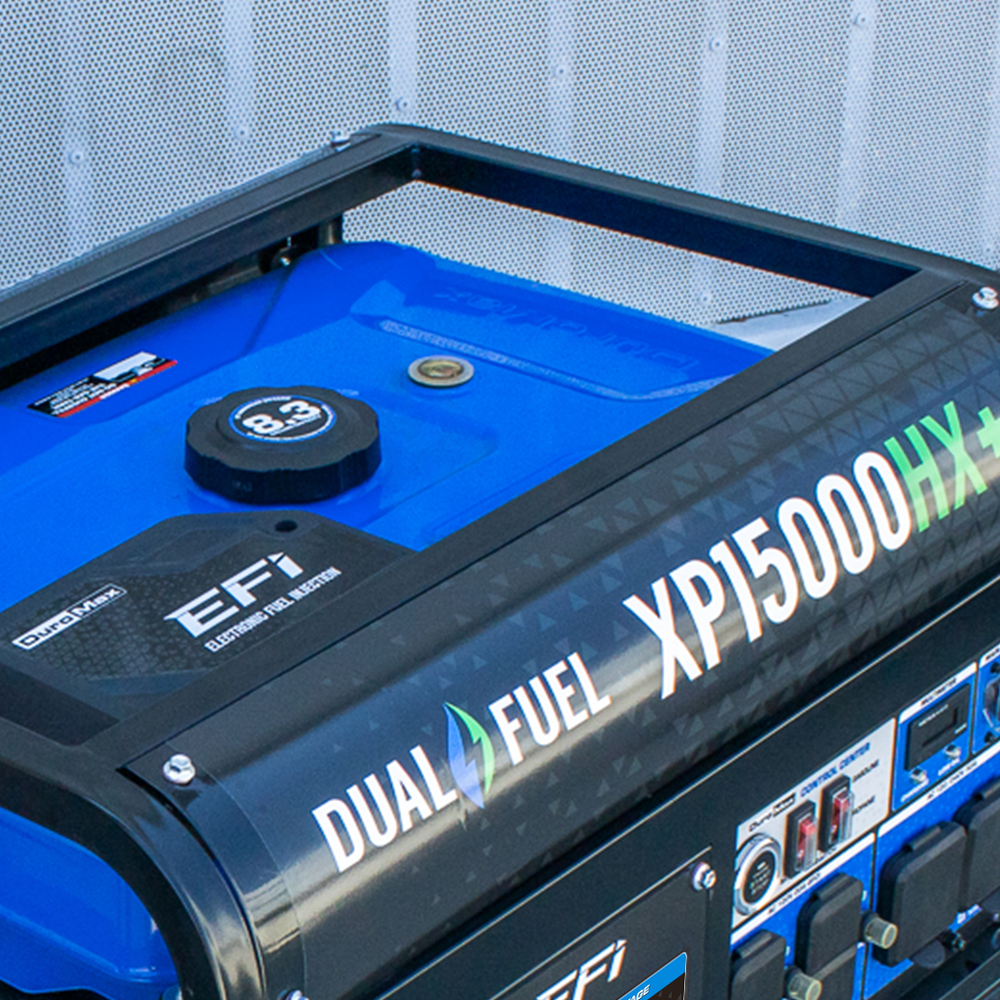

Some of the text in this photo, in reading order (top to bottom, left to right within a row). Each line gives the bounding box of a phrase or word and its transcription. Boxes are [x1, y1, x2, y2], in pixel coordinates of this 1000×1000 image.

[242, 400, 322, 435] 8.3
[16, 586, 124, 650] DuroMax
[204, 566, 342, 653] ELECTRONIC FUEL INJECTION
[312, 746, 459, 872] DUAL
[488, 652, 611, 764] FUEL
[800, 766, 838, 797] CONTROL
[839, 742, 871, 770] CENTER
